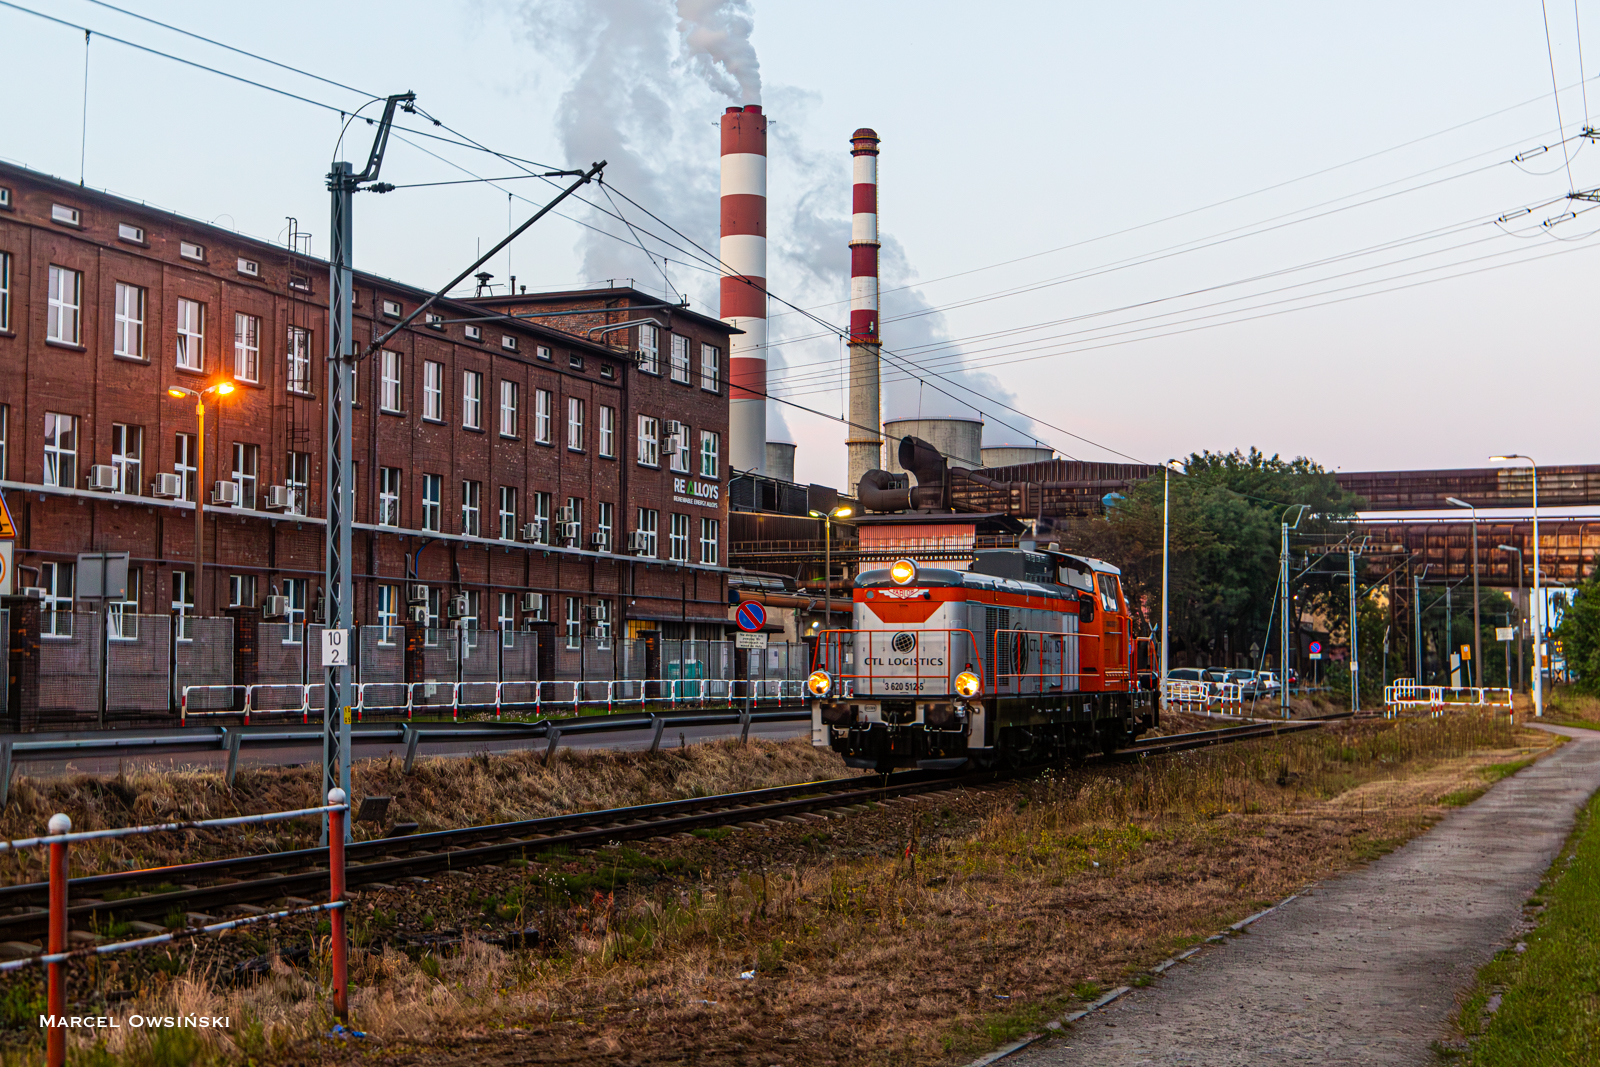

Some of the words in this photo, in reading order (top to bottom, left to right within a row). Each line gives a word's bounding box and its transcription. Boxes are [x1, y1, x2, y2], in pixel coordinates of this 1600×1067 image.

[674, 477, 686, 494] RE
[686, 480, 719, 500] ALLOYS
[328, 631, 341, 646] 10
[331, 649, 340, 664] 2
[864, 657, 884, 666] CTL
[888, 657, 944, 666] LOGISTICS
[884, 682, 890, 691] 3
[890, 682, 904, 691] 620
[904, 682, 924, 691] 512-5
